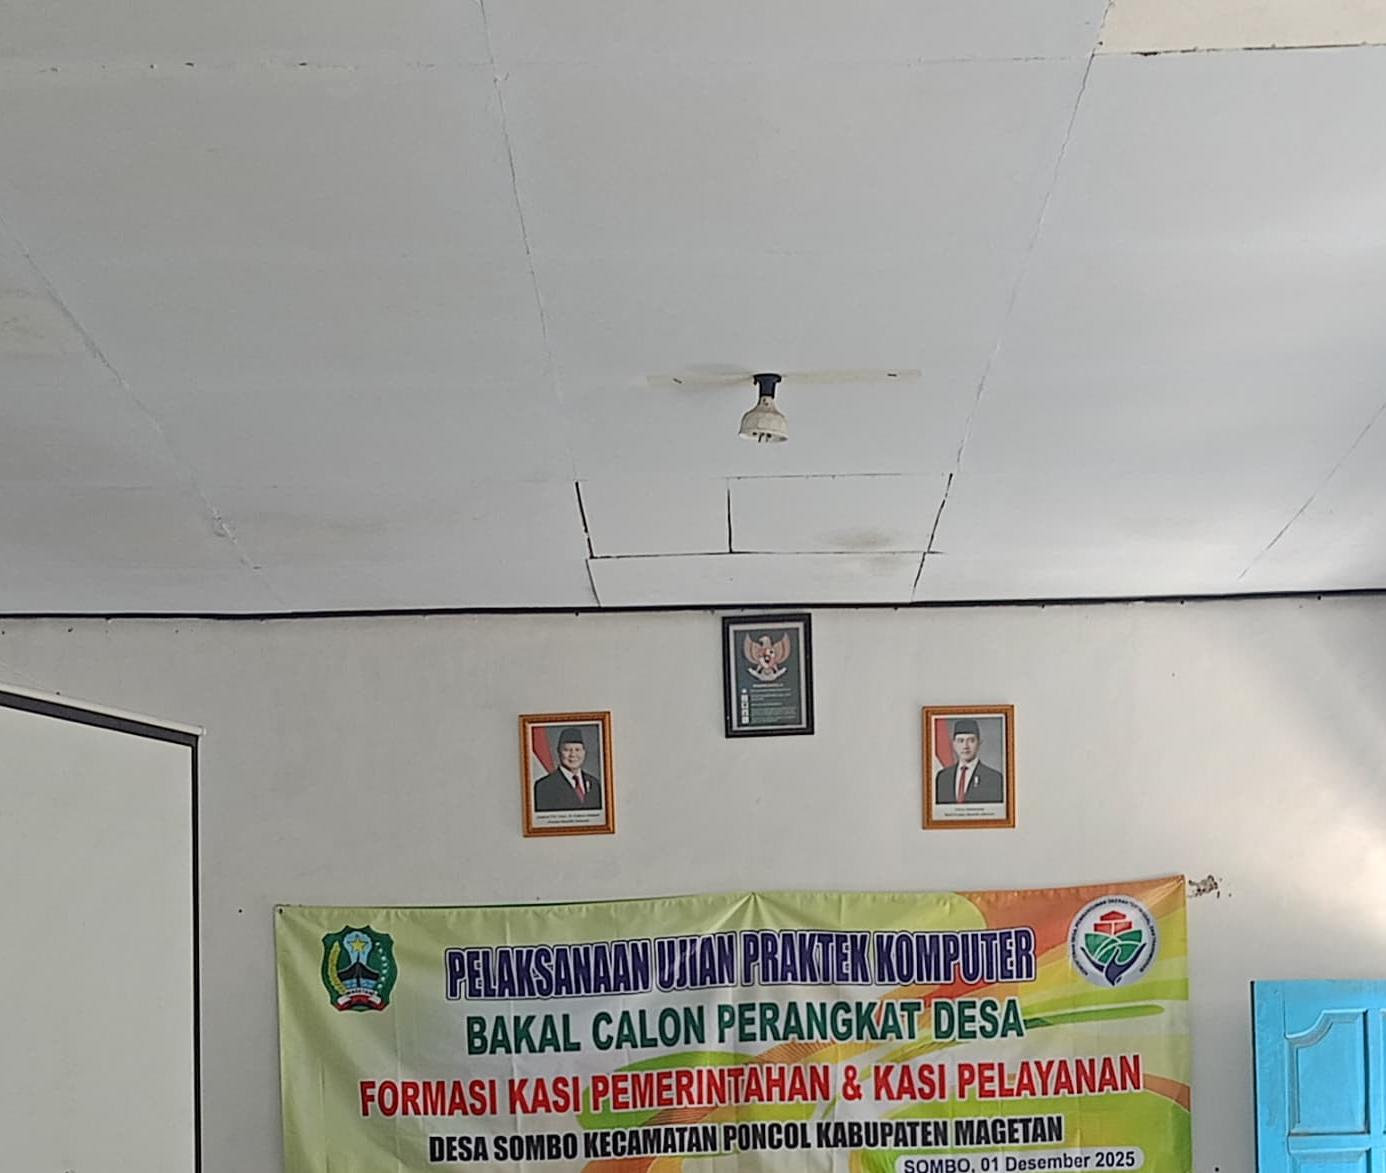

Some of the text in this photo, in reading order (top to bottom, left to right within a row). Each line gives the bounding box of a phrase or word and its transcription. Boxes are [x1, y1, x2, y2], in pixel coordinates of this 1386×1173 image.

[445, 936, 652, 1001] PELAKSANAAN
[655, 932, 737, 992] UJIAN
[742, 929, 871, 987] PRAKTEK
[874, 926, 1036, 984] KOMPUTER
[466, 998, 1025, 1055] BAKAL CALON PERANGKAT DESA
[359, 1055, 1141, 1117] FORMASI KASI PEMERINTAHAN & KASI PELAYANAN
[428, 1115, 1063, 1162] DESA SOMBO KECAMATAN PONCOL KABUPATEN MAGETAN
[980, 1157, 1000, 1173] 01
[1005, 1153, 1090, 1173] Desember
[1094, 1150, 1136, 1169] 2025
